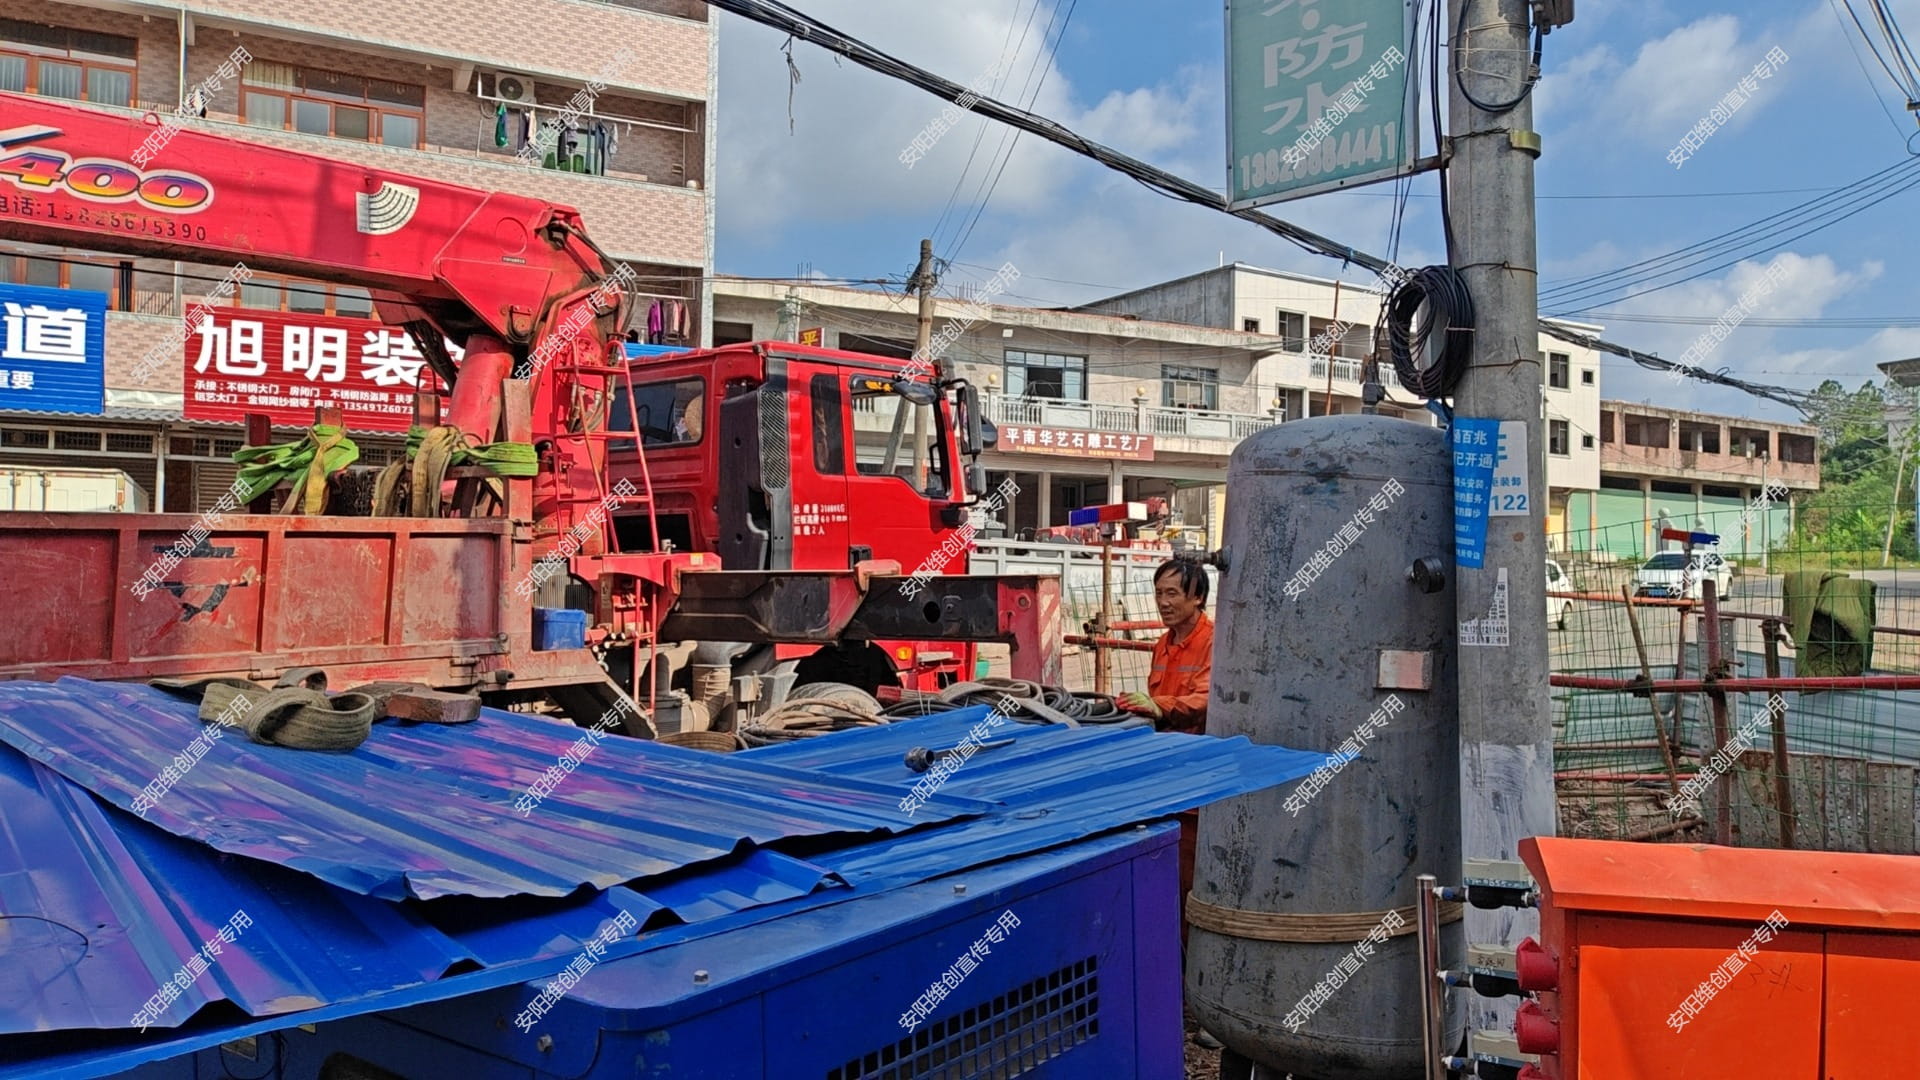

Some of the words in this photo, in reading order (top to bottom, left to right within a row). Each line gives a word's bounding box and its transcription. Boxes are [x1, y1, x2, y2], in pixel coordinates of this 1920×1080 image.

[2, 302, 88, 363] 道
[193, 314, 465, 390] 旭明装
[1005, 427, 1148, 451] 平南华艺石雕工艺厂
